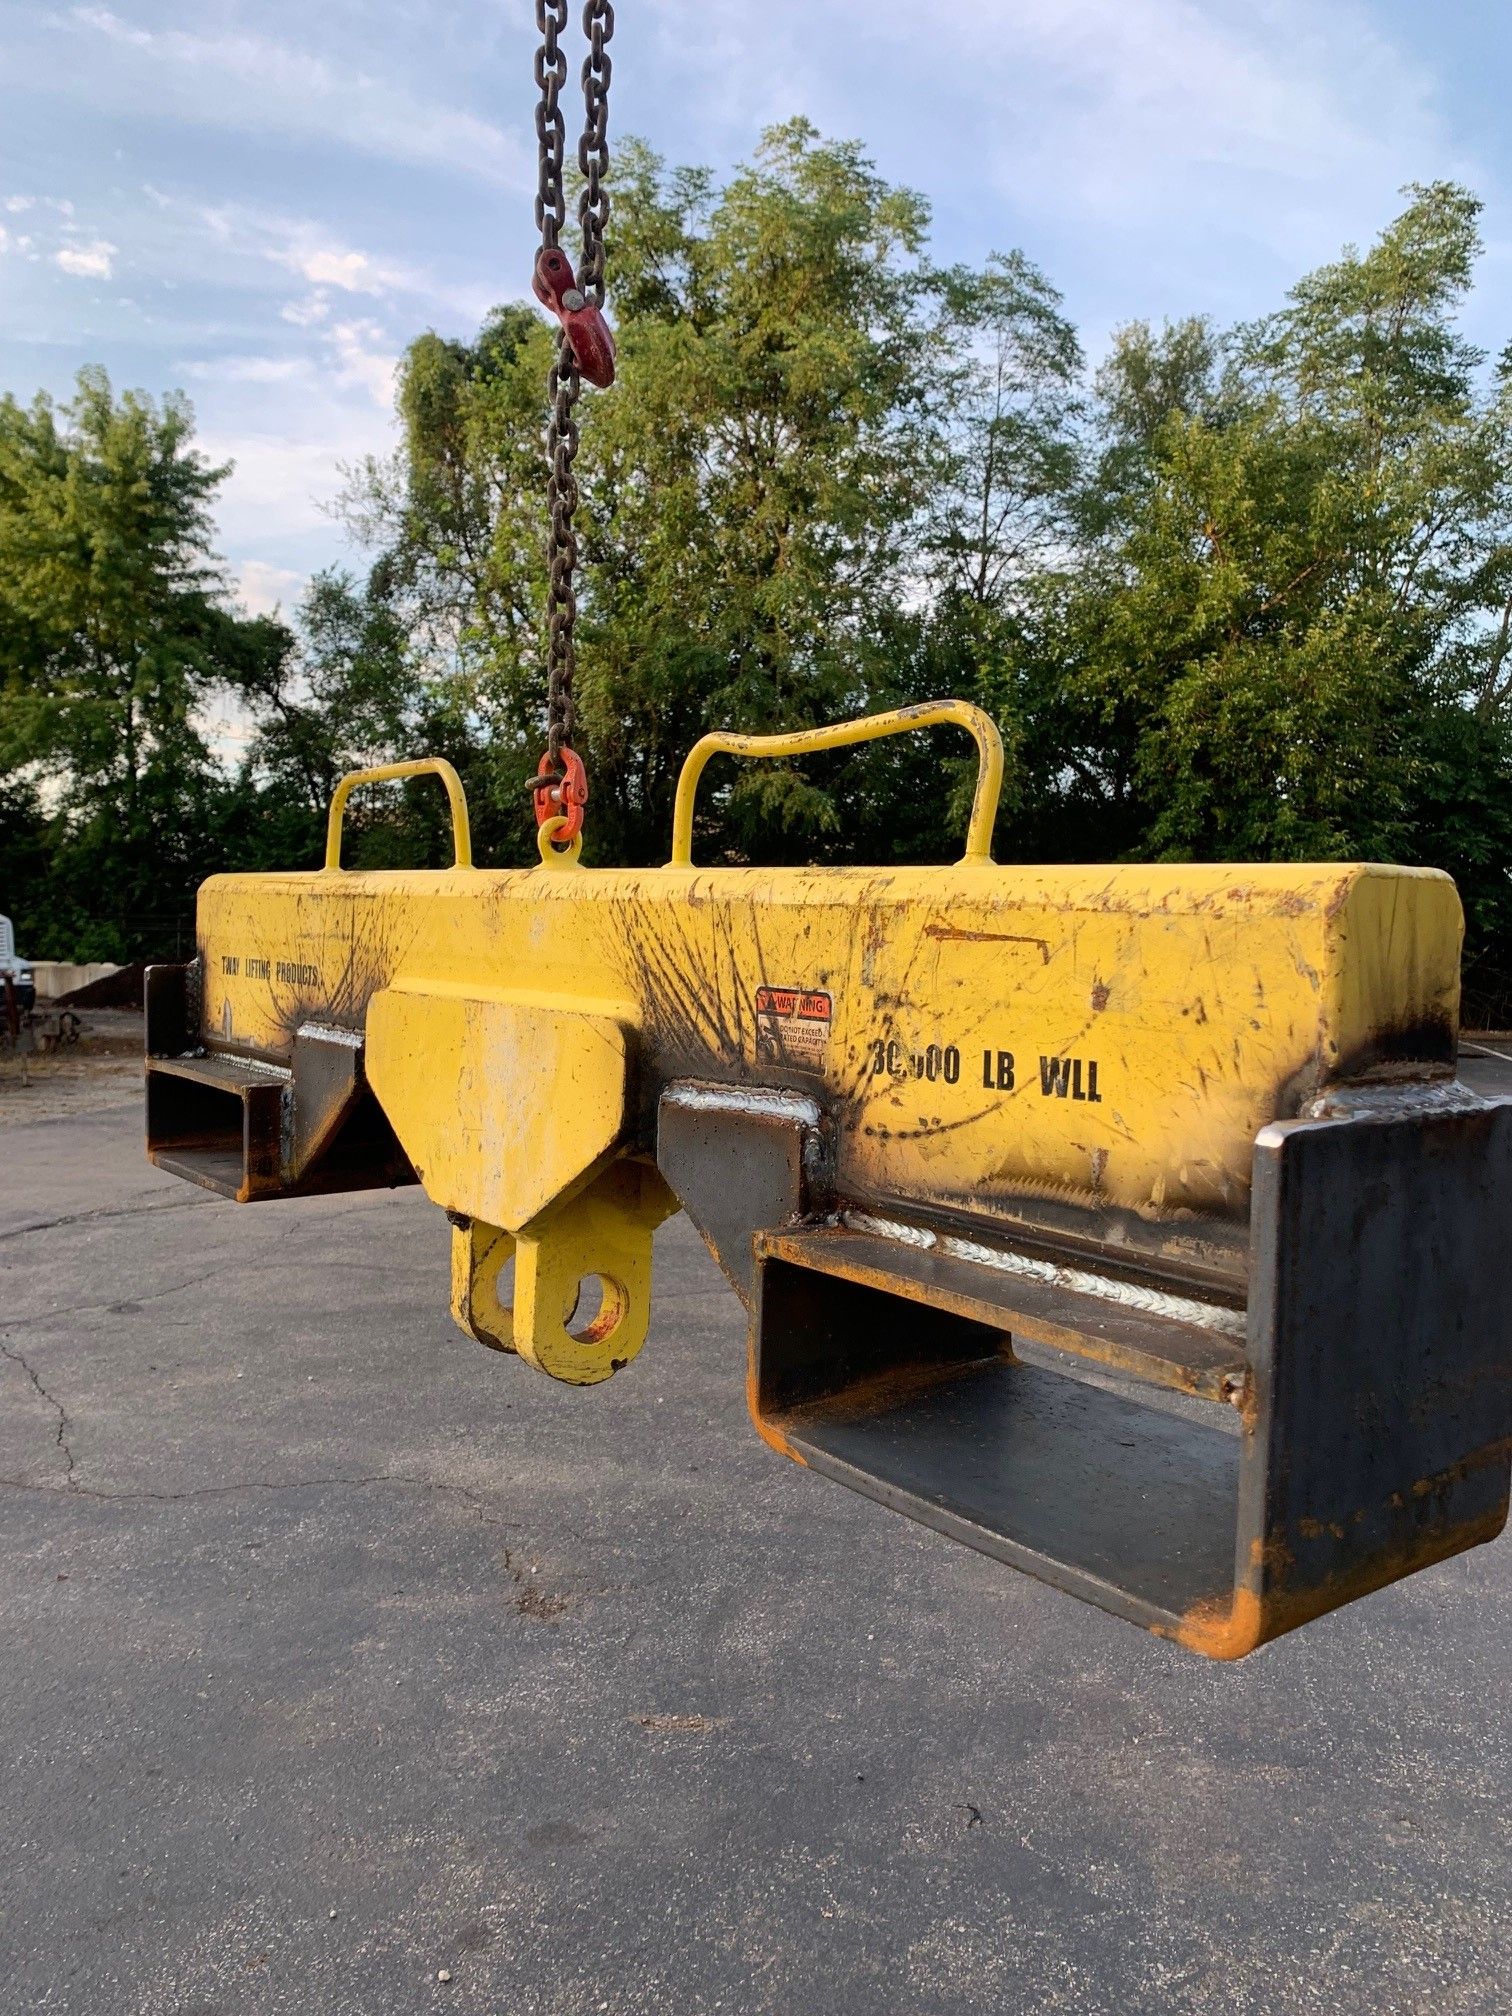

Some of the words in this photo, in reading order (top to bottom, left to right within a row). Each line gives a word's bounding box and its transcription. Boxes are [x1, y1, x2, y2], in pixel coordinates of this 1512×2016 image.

[245, 957, 271, 981] LIFTING
[276, 961, 319, 987] PRODUCTS
[788, 1026, 801, 1035] NOT
[801, 1027, 823, 1038] EXCEED
[983, 1049, 1015, 1091] LB
[1040, 1055, 1102, 1103] WLL
